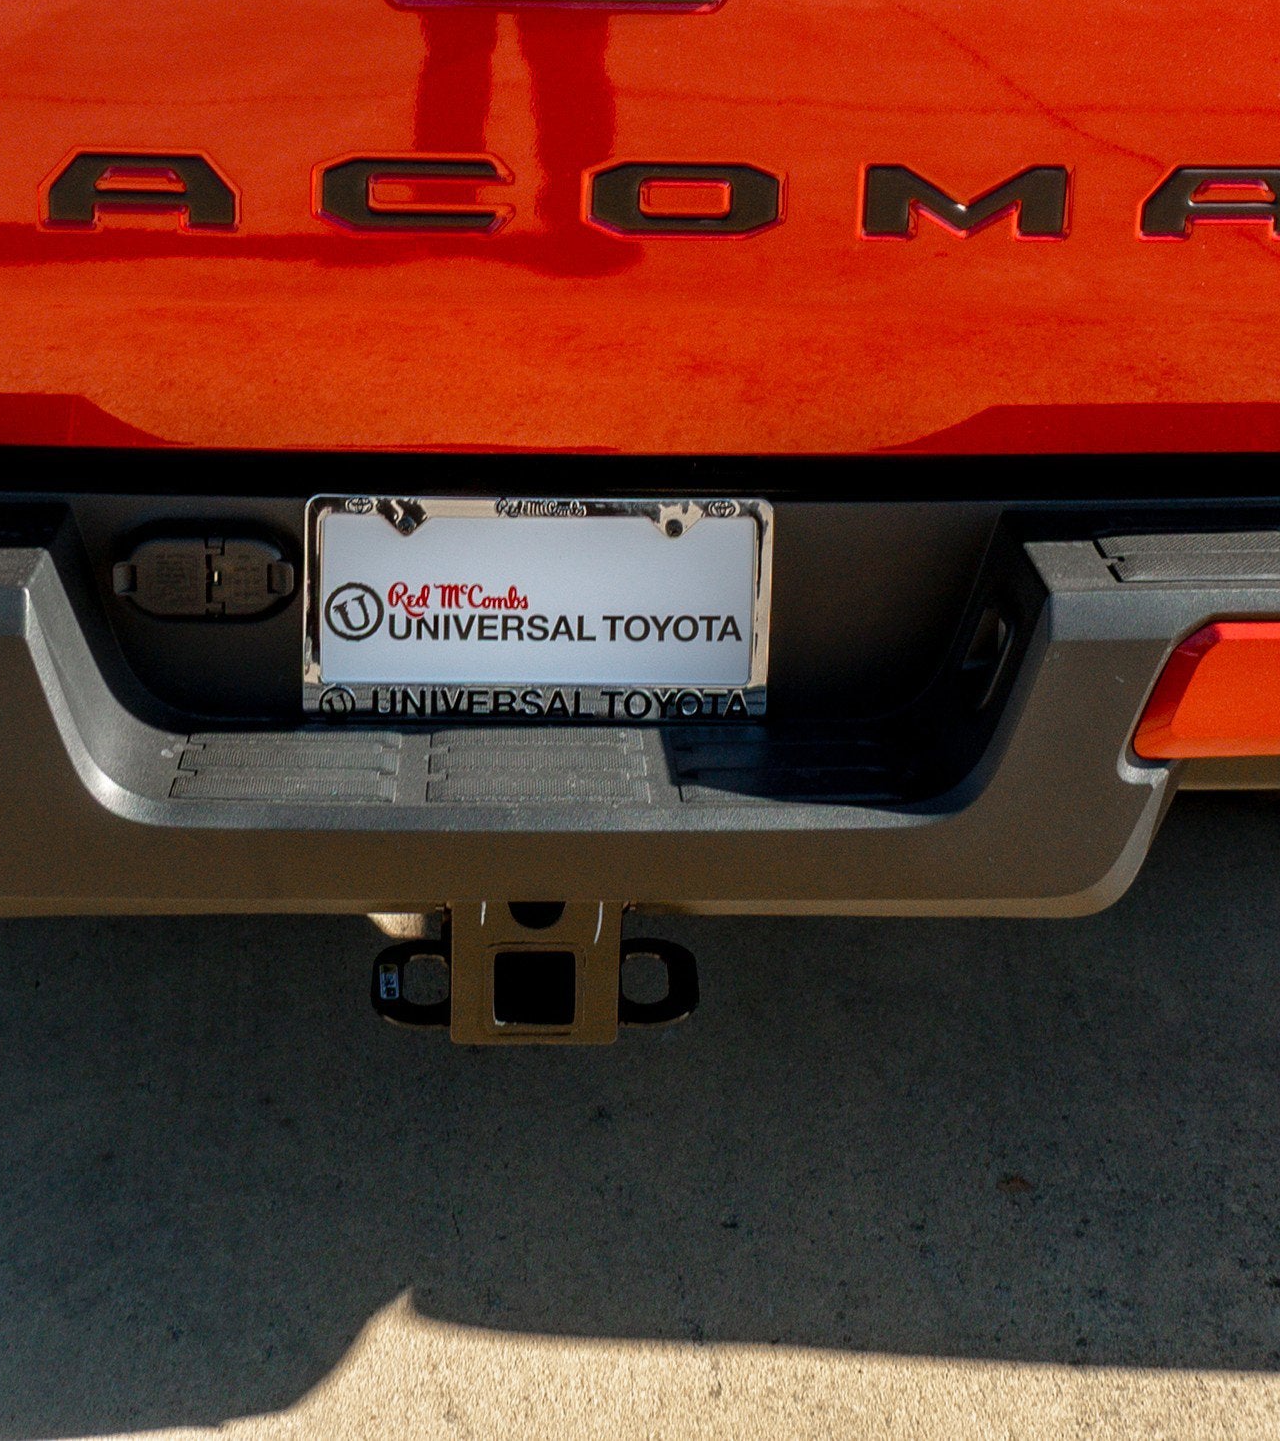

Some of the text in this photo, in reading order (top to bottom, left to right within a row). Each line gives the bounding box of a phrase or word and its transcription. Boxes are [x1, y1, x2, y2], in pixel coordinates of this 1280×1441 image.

[387, 582, 529, 618] Red McCombs
[388, 614, 743, 643] UNIVERSAL TOYOTA
[372, 687, 749, 719] UNIVERSAL TOYOTA
